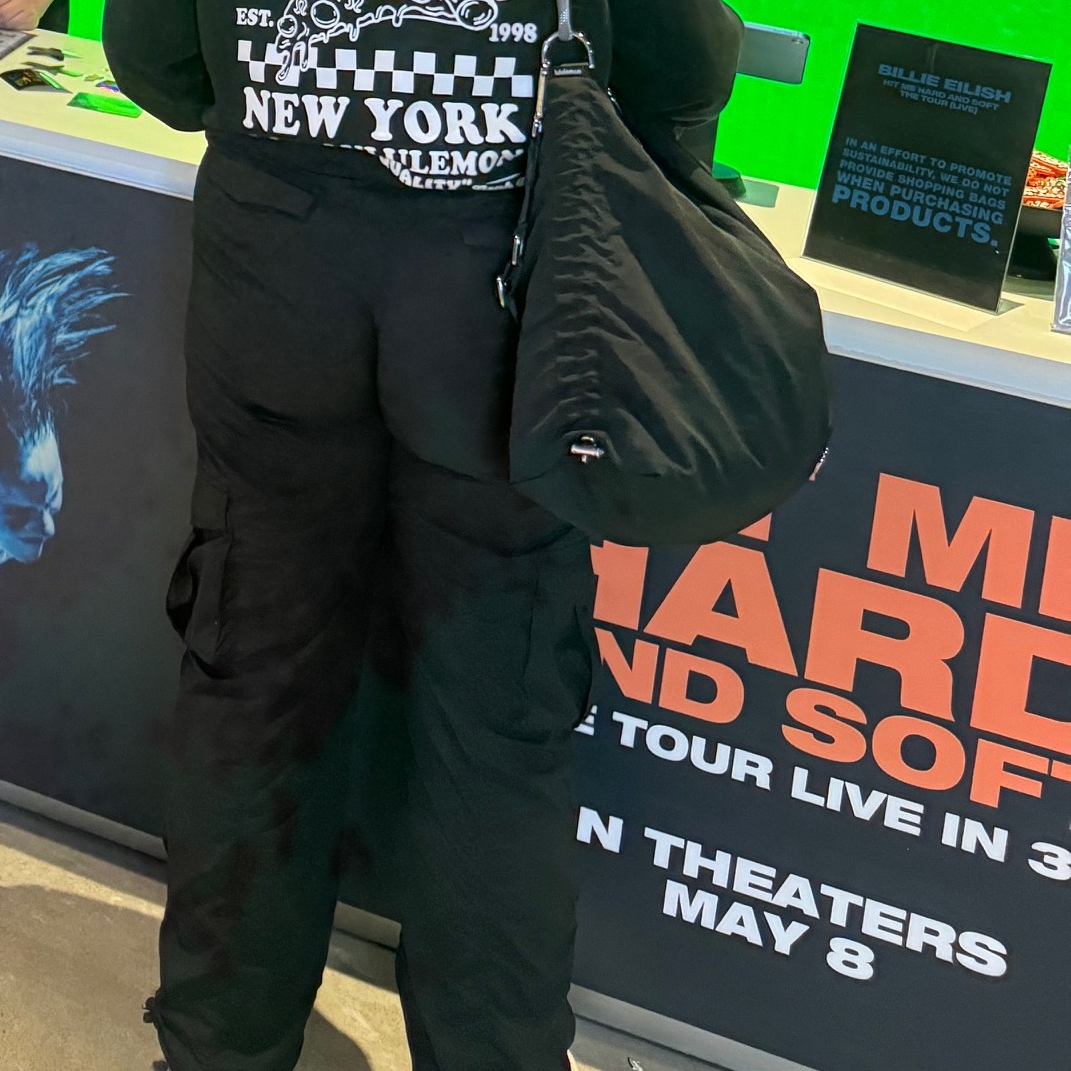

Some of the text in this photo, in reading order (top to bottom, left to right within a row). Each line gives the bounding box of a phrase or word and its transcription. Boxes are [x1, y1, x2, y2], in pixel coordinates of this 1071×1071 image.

[235, 7, 538, 44] EST. 1998
[878, 63, 1012, 103] BILLIE EILISH
[882, 78, 1000, 111] HIT ME HARD AND SOFT
[899, 90, 919, 101] THE
[920, 94, 949, 108] TOUR
[242, 87, 527, 145] NEW YORK
[839, 158, 1007, 210] PROVIDE SHOPPING BAGS
[842, 147, 1011, 198] SUSTAINABILITY, WE DO NOT
[845, 136, 1013, 186] IN AN EFFORT TO PROMOTE
[832, 183, 999, 248] PRODUCTS.
[836, 170, 1004, 225] WHEN PURCHASING
[782, 686, 1071, 809] SOF
[612, 710, 774, 791] TOUR
[790, 766, 925, 837] LIVE
[941, 812, 1009, 863] IN
[644, 826, 1008, 979] THEATERS
[662, 879, 876, 981] MAY 8
